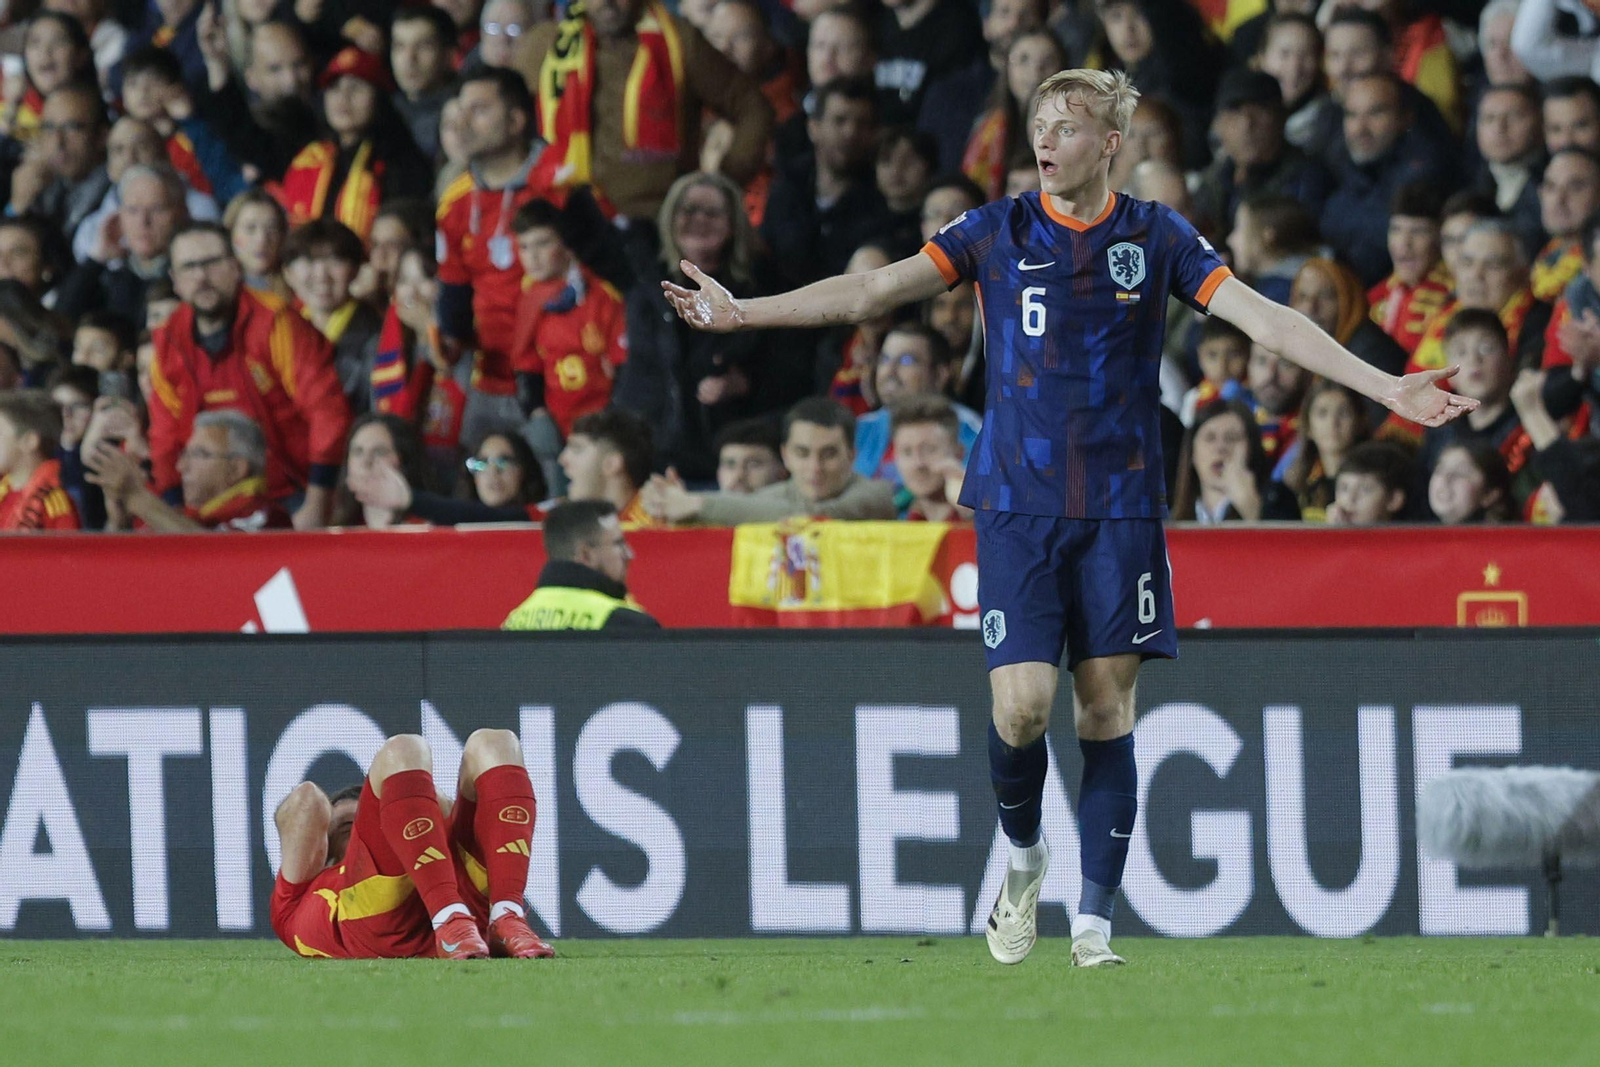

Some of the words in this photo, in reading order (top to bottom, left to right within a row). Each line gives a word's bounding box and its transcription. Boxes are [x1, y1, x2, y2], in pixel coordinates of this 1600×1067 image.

[1022, 286, 1046, 337] 6
[1137, 572, 1157, 624] 6
[746, 701, 1531, 938] LEAGUE
